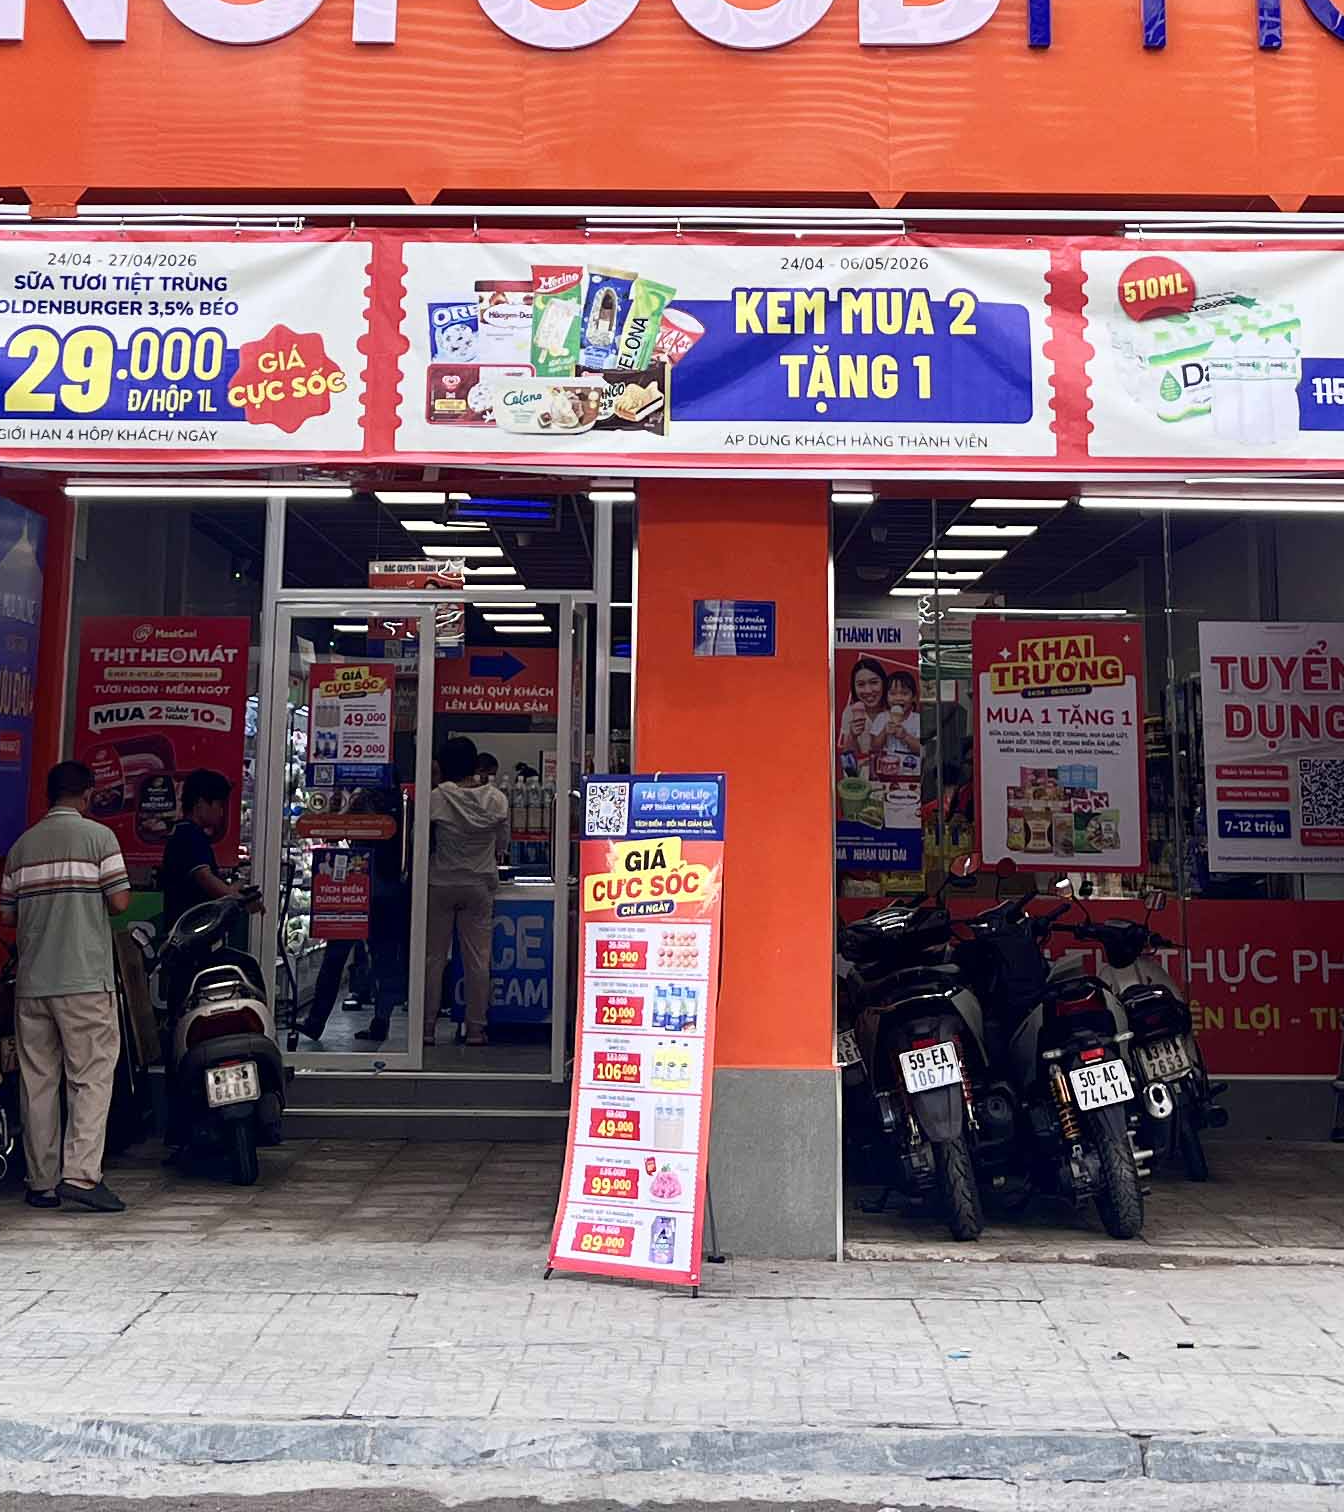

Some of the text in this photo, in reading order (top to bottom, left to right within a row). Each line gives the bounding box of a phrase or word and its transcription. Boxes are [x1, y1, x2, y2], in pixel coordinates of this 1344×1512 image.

[47, 252, 198, 268] 24/04 27/04/2026
[780, 257, 929, 271] 24/04 06/05/2026
[14, 270, 228, 297] SỮA TƯƠI TIỆT TRÙNG
[539, 271, 579, 290] Merino
[1122, 272, 1189, 304] 510ML
[147, 301, 194, 318] 3,5%
[199, 296, 240, 316] BÉO
[433, 304, 479, 325] ORE
[735, 291, 977, 335] KEM MUA 2
[256, 342, 307, 375] GIÁ
[3, 328, 224, 414] 29.000
[779, 344, 931, 413] TẶNG 1
[227, 367, 348, 414] CỰC SỐC
[127, 385, 217, 419] Đ/HỘP 1L
[65, 429, 74, 440] 4
[795, 431, 846, 448] KHÁCH
[851, 432, 894, 448] HÀNG
[90, 644, 239, 664] THỊT HEO MÁT
[1021, 638, 1092, 662] KHAI
[342, 669, 363, 681] GIÁ
[992, 659, 1121, 687] TRƯƠNG
[440, 685, 460, 696] XIN
[513, 684, 554, 697] KHÁCH
[445, 698, 466, 711] LÊN
[495, 701, 522, 712] MUA
[94, 706, 163, 725] MUA 2
[343, 712, 387, 727] 49.000
[987, 703, 1133, 730] MUA 1 TẶNG 1
[342, 743, 385, 758] 29.000
[1224, 820, 1285, 836] 7-12 triệu
[624, 842, 667, 872] GIÁ
[592, 863, 700, 906] CỰC SỐC
[492, 915, 545, 971] CE
[602, 950, 639, 968] 19.900
[602, 1006, 636, 1024] 29.000
[1233, 1002, 1281, 1037] LỢI
[908, 1047, 949, 1070] 59-EA
[597, 1063, 638, 1081] 106.000
[1078, 1065, 1119, 1088] 50-AC
[597, 1120, 635, 1137] 49.000
[591, 1177, 632, 1195] 99.000
[581, 1235, 625, 1252] 89.000
